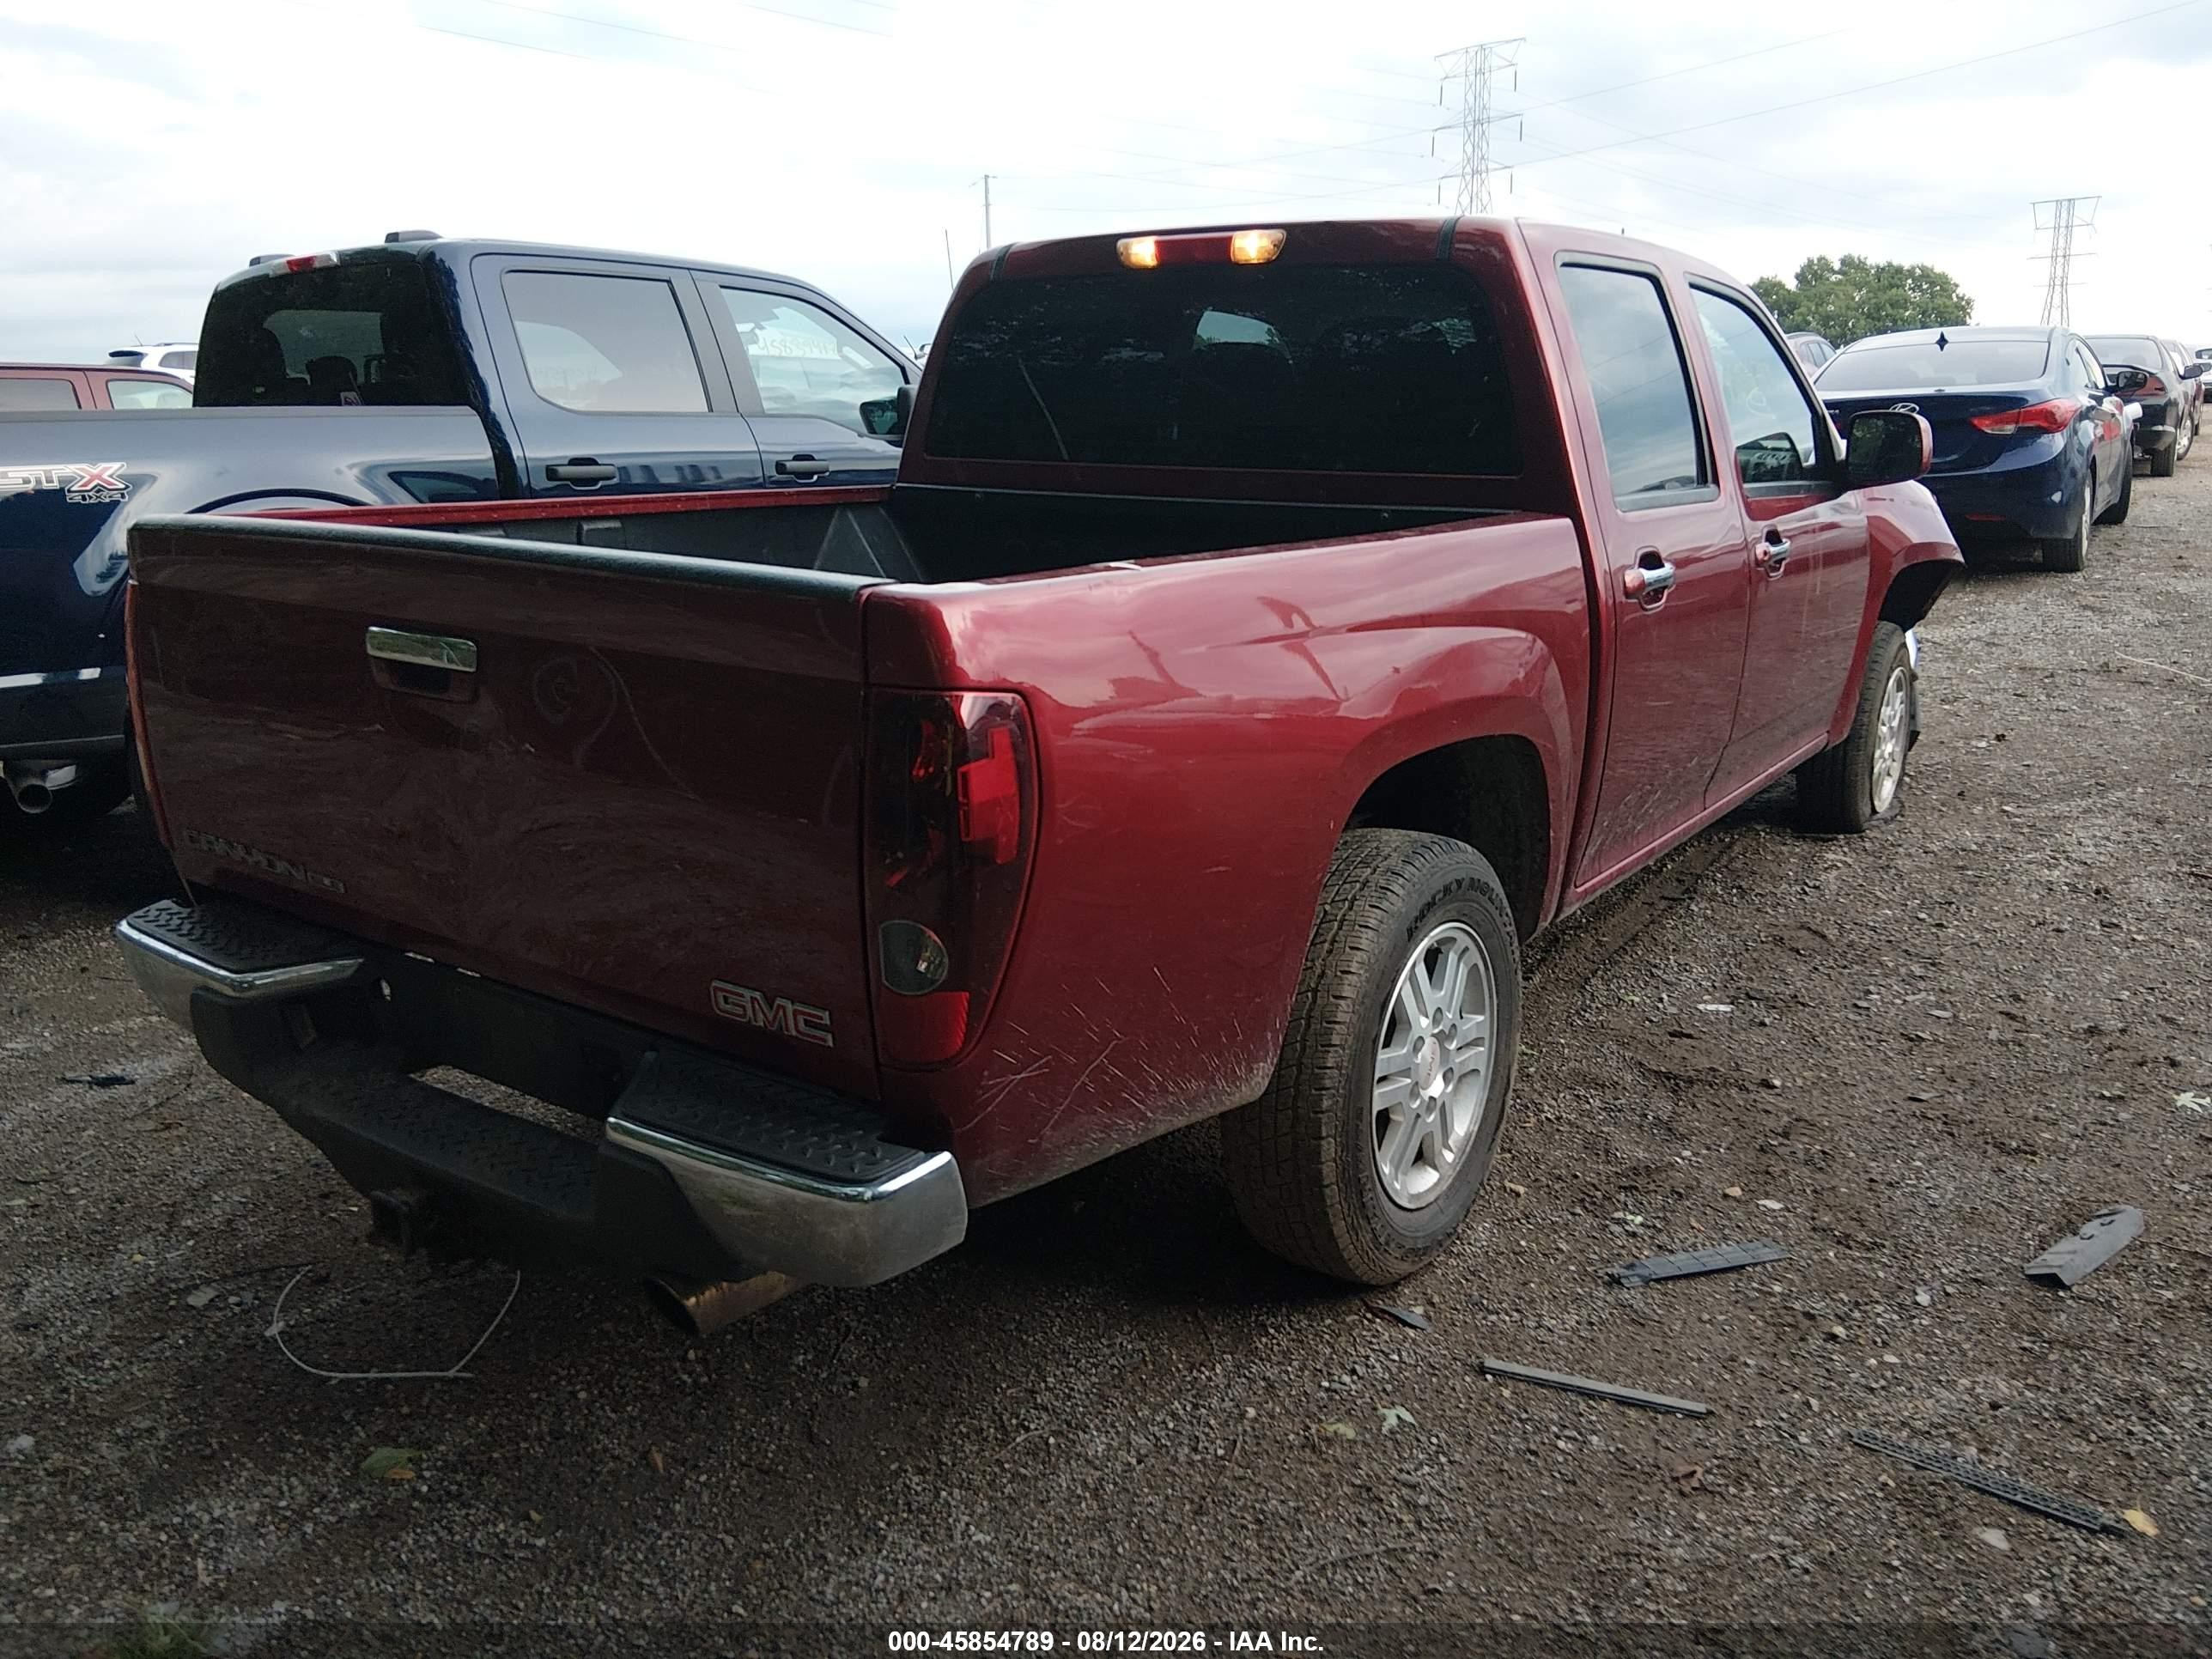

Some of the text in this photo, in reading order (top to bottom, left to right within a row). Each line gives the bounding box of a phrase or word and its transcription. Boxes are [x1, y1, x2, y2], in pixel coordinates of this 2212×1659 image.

[0, 462, 132, 494] STX
[1406, 876, 1466, 942] ROCKY
[709, 978, 834, 1048] GMC
